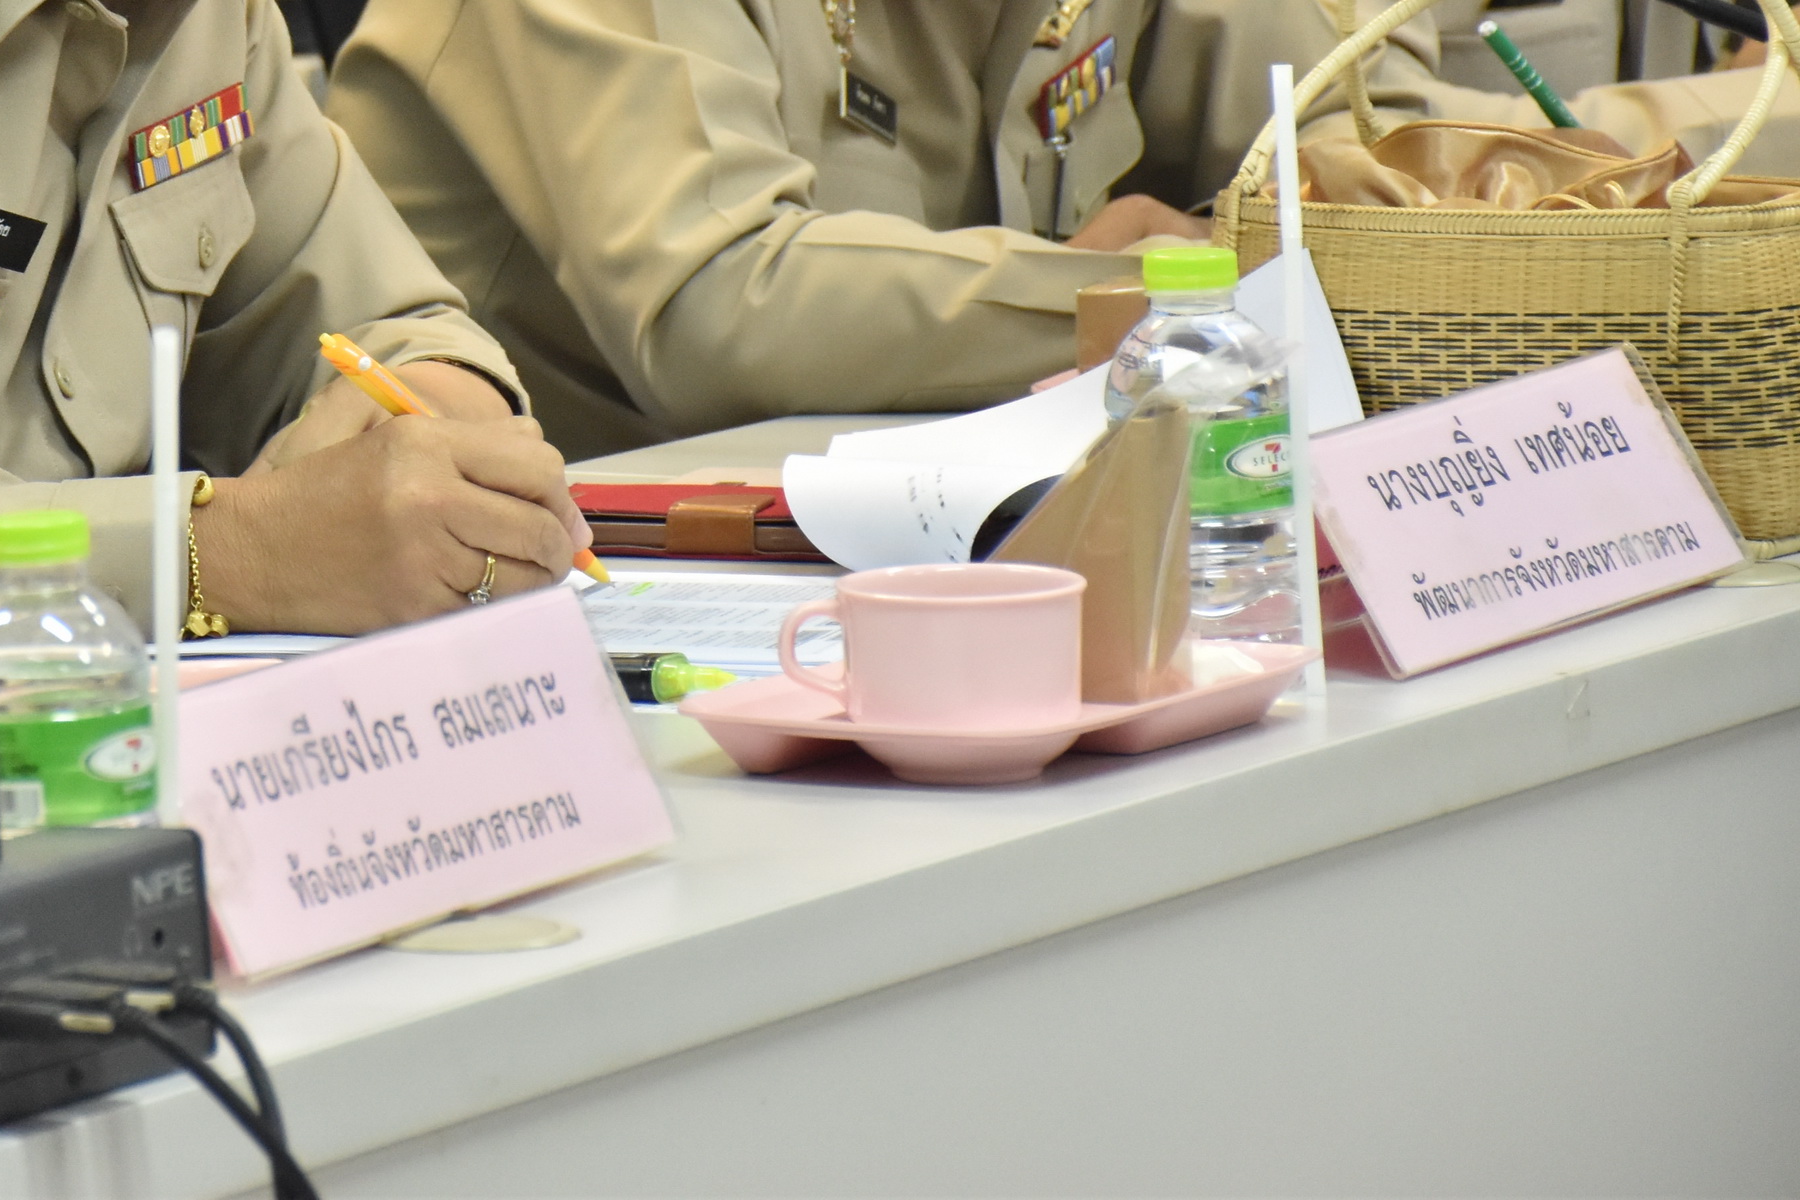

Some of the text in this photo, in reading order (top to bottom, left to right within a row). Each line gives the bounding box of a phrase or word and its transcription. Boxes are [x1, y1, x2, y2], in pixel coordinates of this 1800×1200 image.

[1253, 452, 1289, 467] SELEC
[1367, 401, 1632, 517] นางบุญยิ่ง เทศน้อย
[1412, 521, 1700, 620] พัฒนาการจังหวัดมหาสารคาม
[211, 672, 566, 810] นายเกรียงไกร สมเสนาะ
[287, 791, 581, 910] ท้องถิ่นจังหวัดมหาสารคาม
